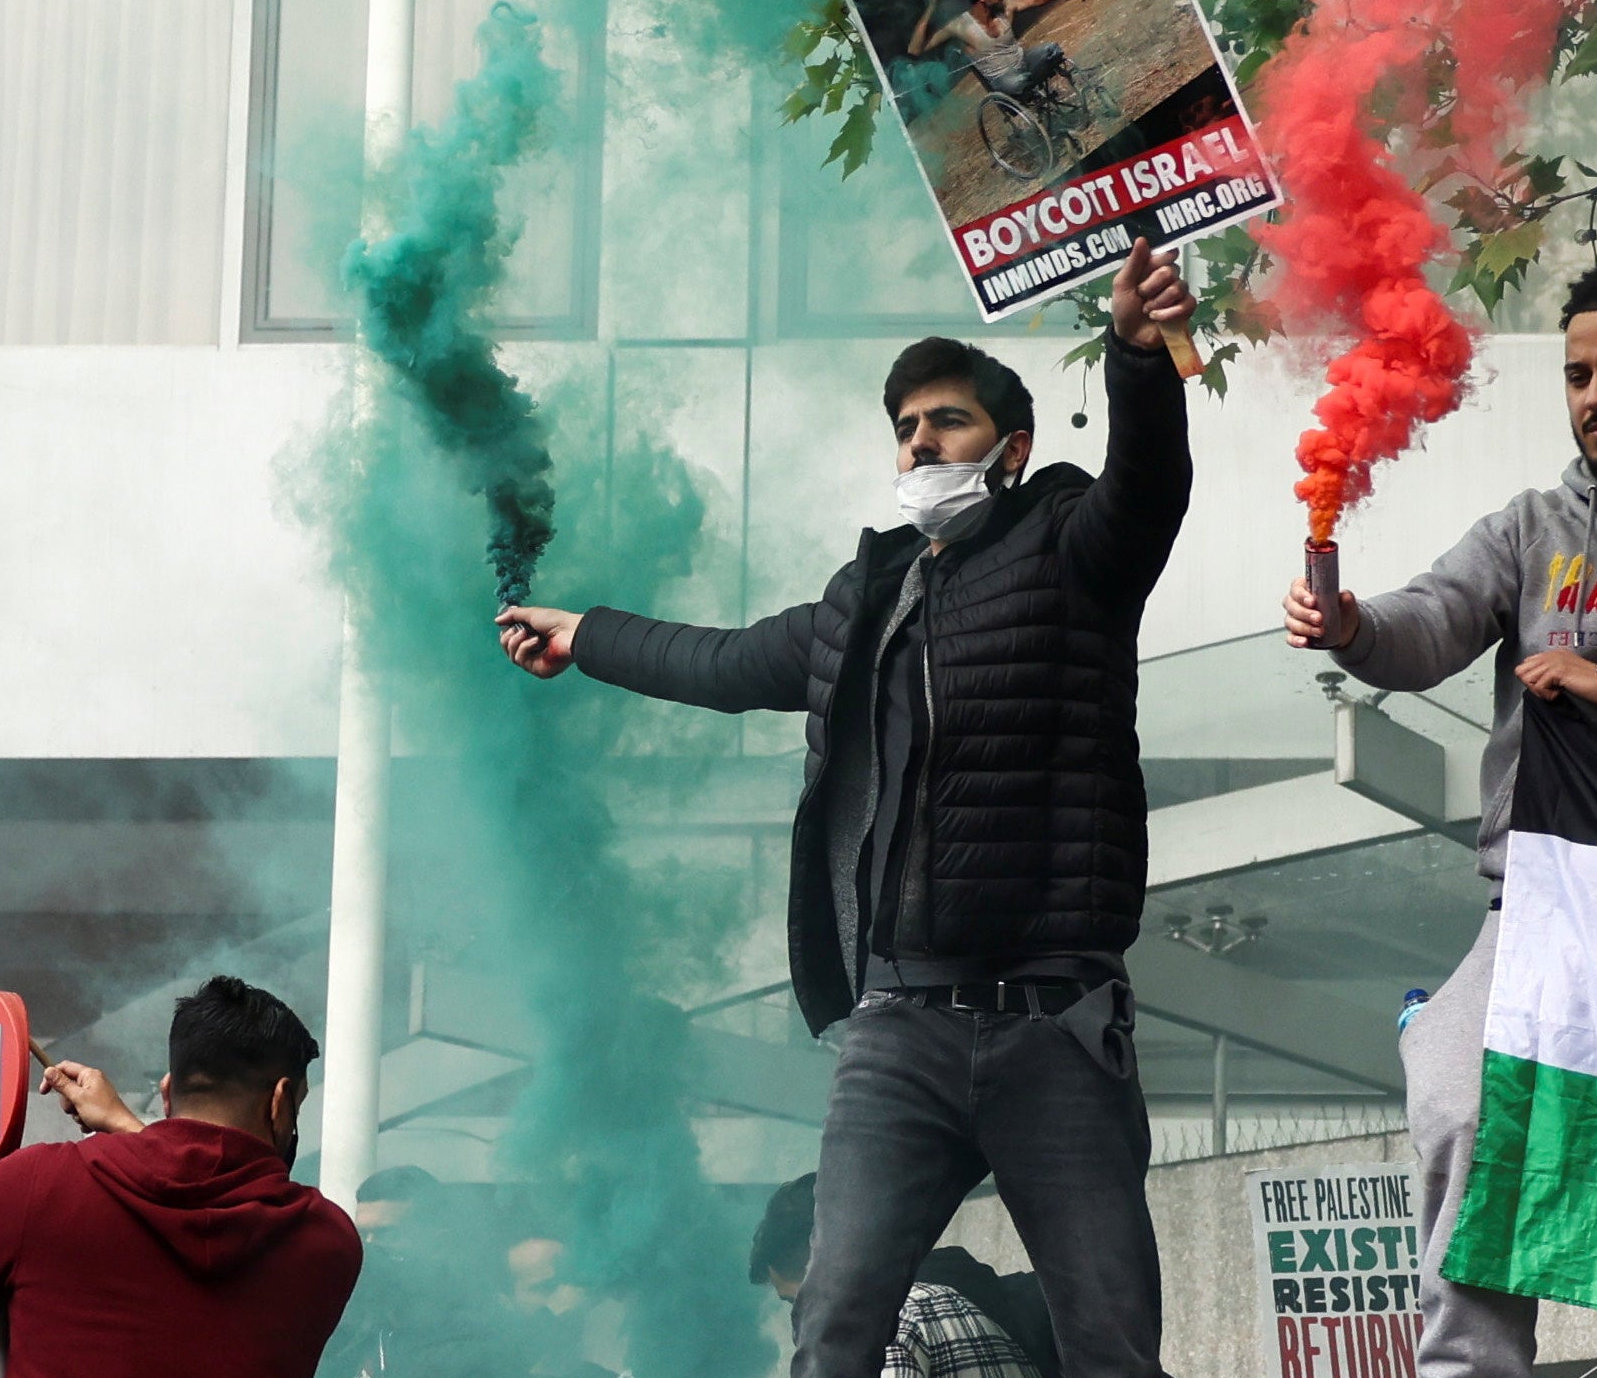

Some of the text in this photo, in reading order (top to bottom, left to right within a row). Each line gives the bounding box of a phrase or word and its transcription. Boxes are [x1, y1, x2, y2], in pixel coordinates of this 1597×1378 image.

[964, 126, 1249, 269] BOYCOTT ISRAEL
[982, 172, 1267, 305] INMINDS.COM IHRC.ORG
[1260, 1175, 1414, 1223] FREE PALESTINE
[1267, 1226, 1418, 1273] EXIST!
[1273, 1275, 1421, 1314] RESIST!
